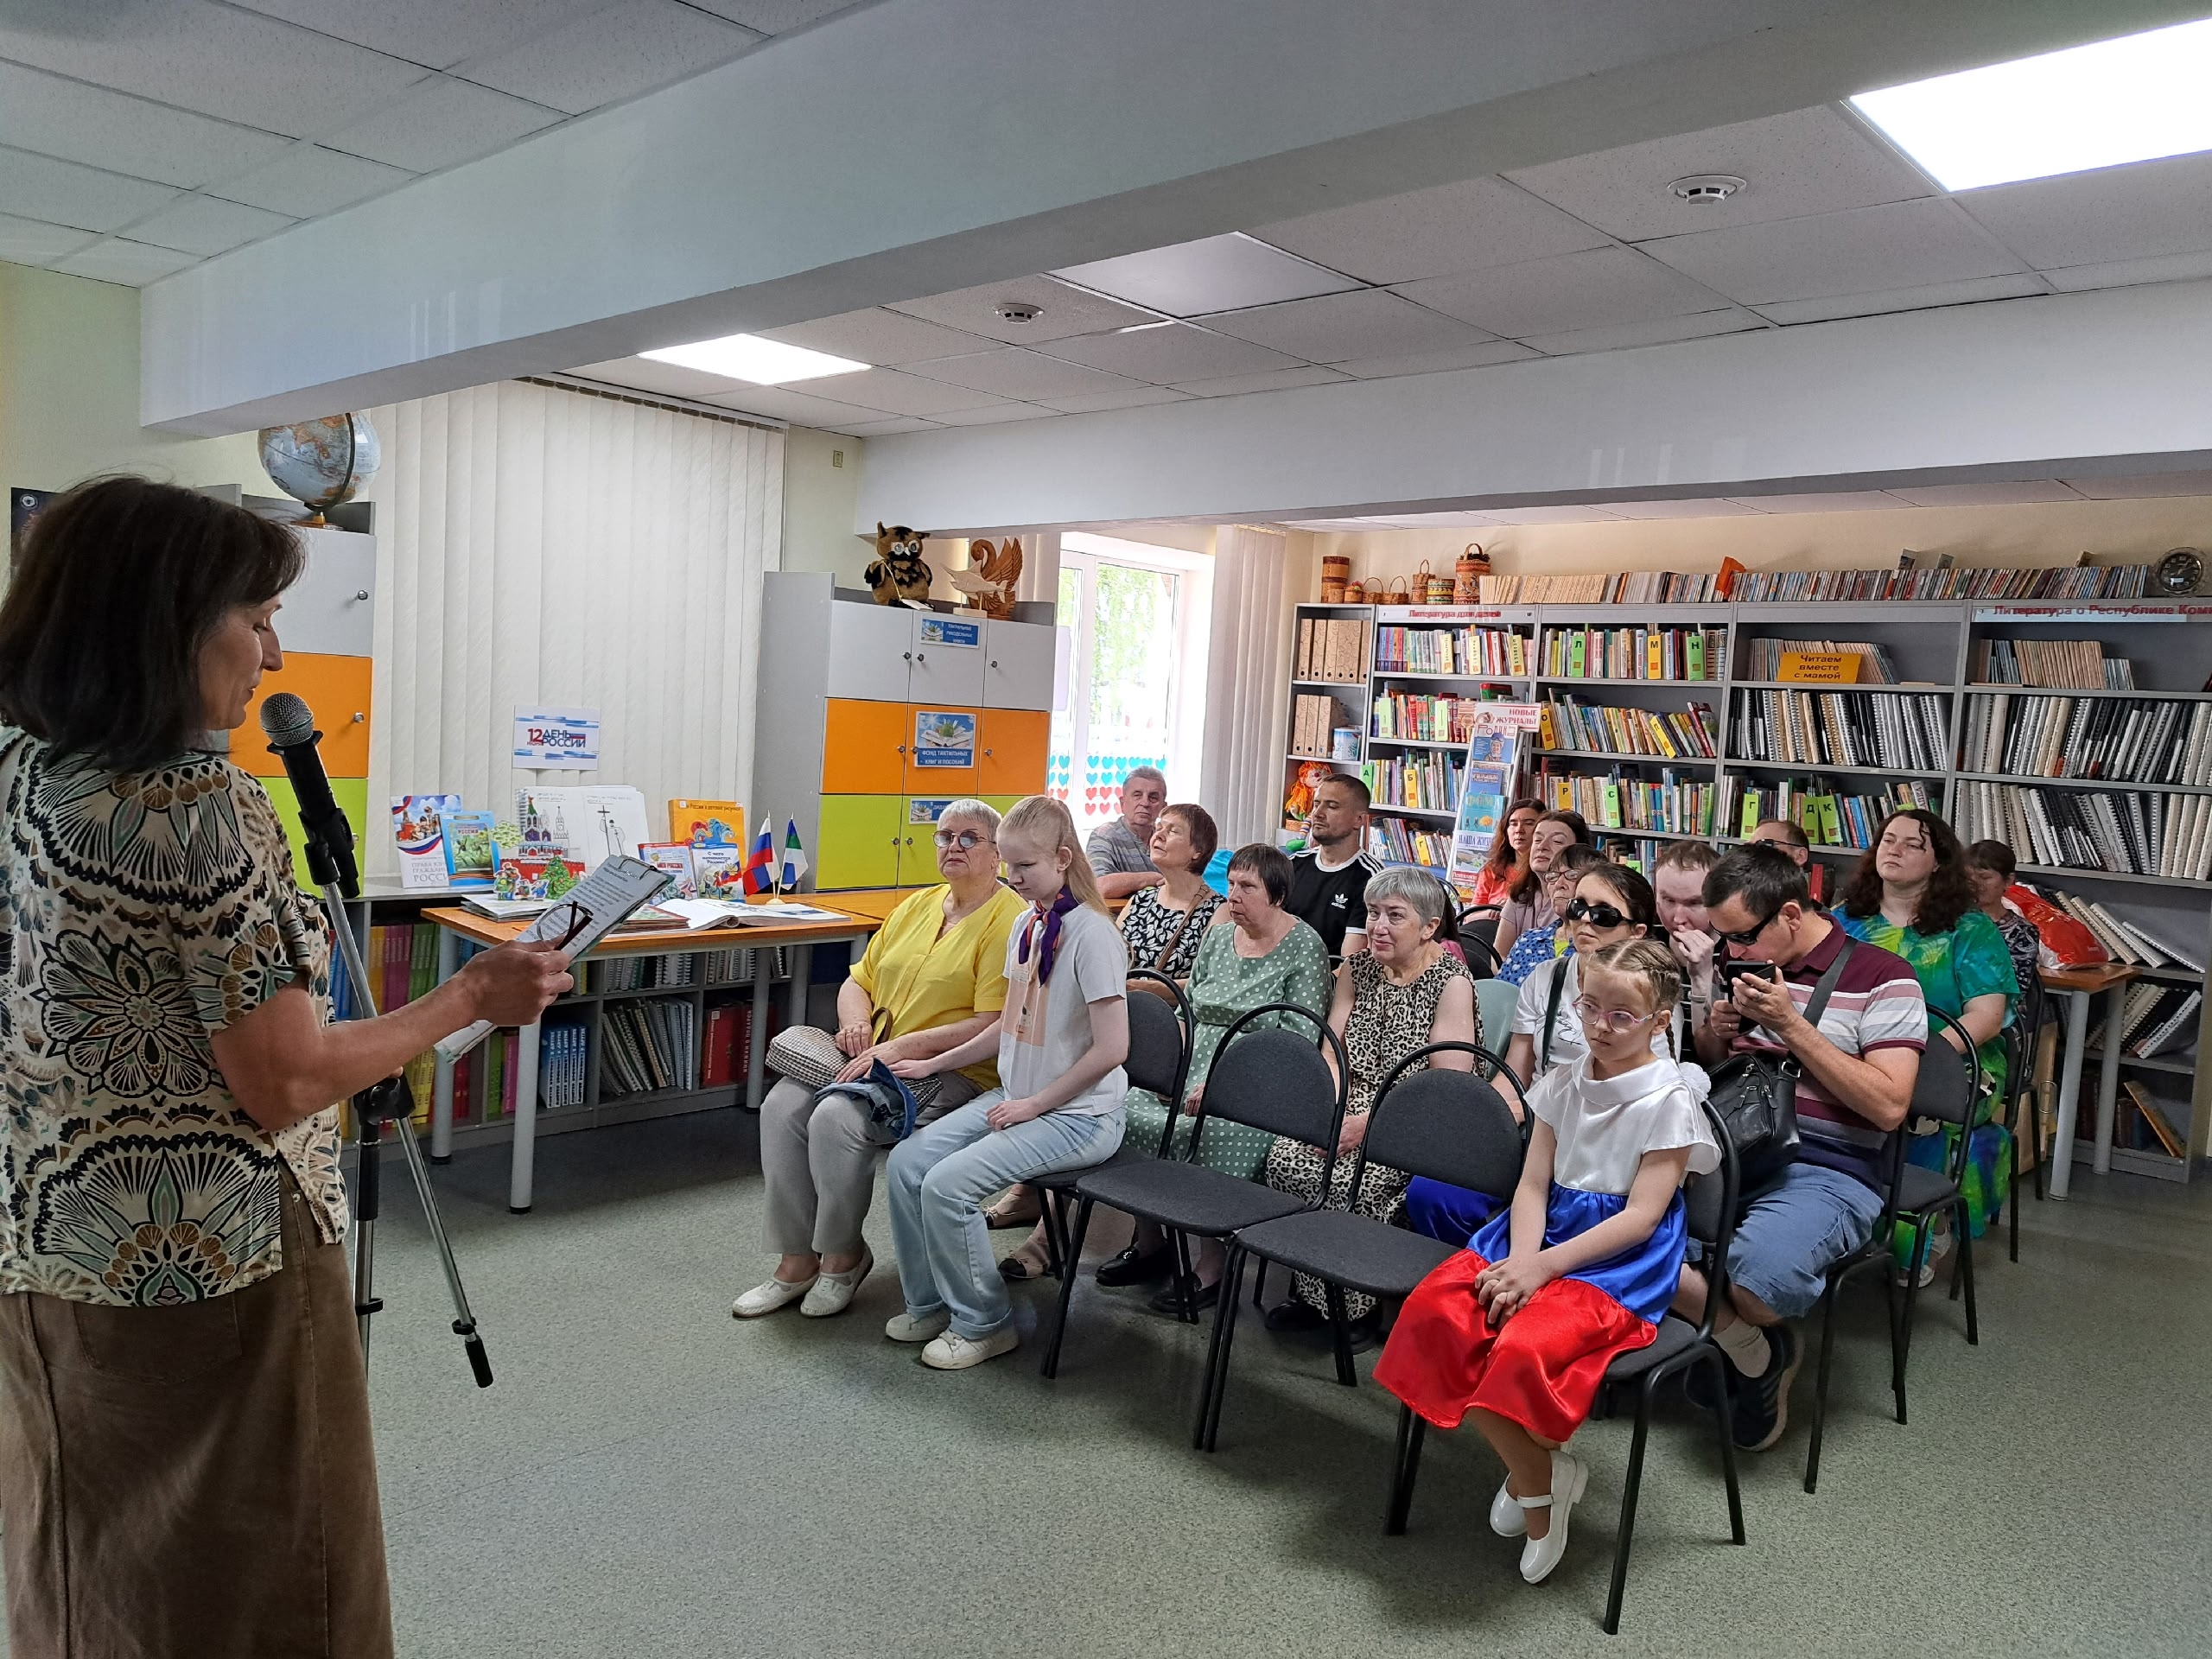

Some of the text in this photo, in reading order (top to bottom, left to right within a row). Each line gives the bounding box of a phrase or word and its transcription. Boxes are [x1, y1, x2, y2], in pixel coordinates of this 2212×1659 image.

[1409, 610, 1456, 619] Литература
[1993, 605, 2072, 617] Литература
[2088, 605, 2174, 617] Республике
[1496, 716, 1537, 725] ЖУРНАЛЫ
[527, 728, 571, 742] 12 ДЕНЬ
[543, 738, 586, 747] РОССИИ
[1806, 804, 1815, 814] Д
[1823, 803, 1832, 811] К
